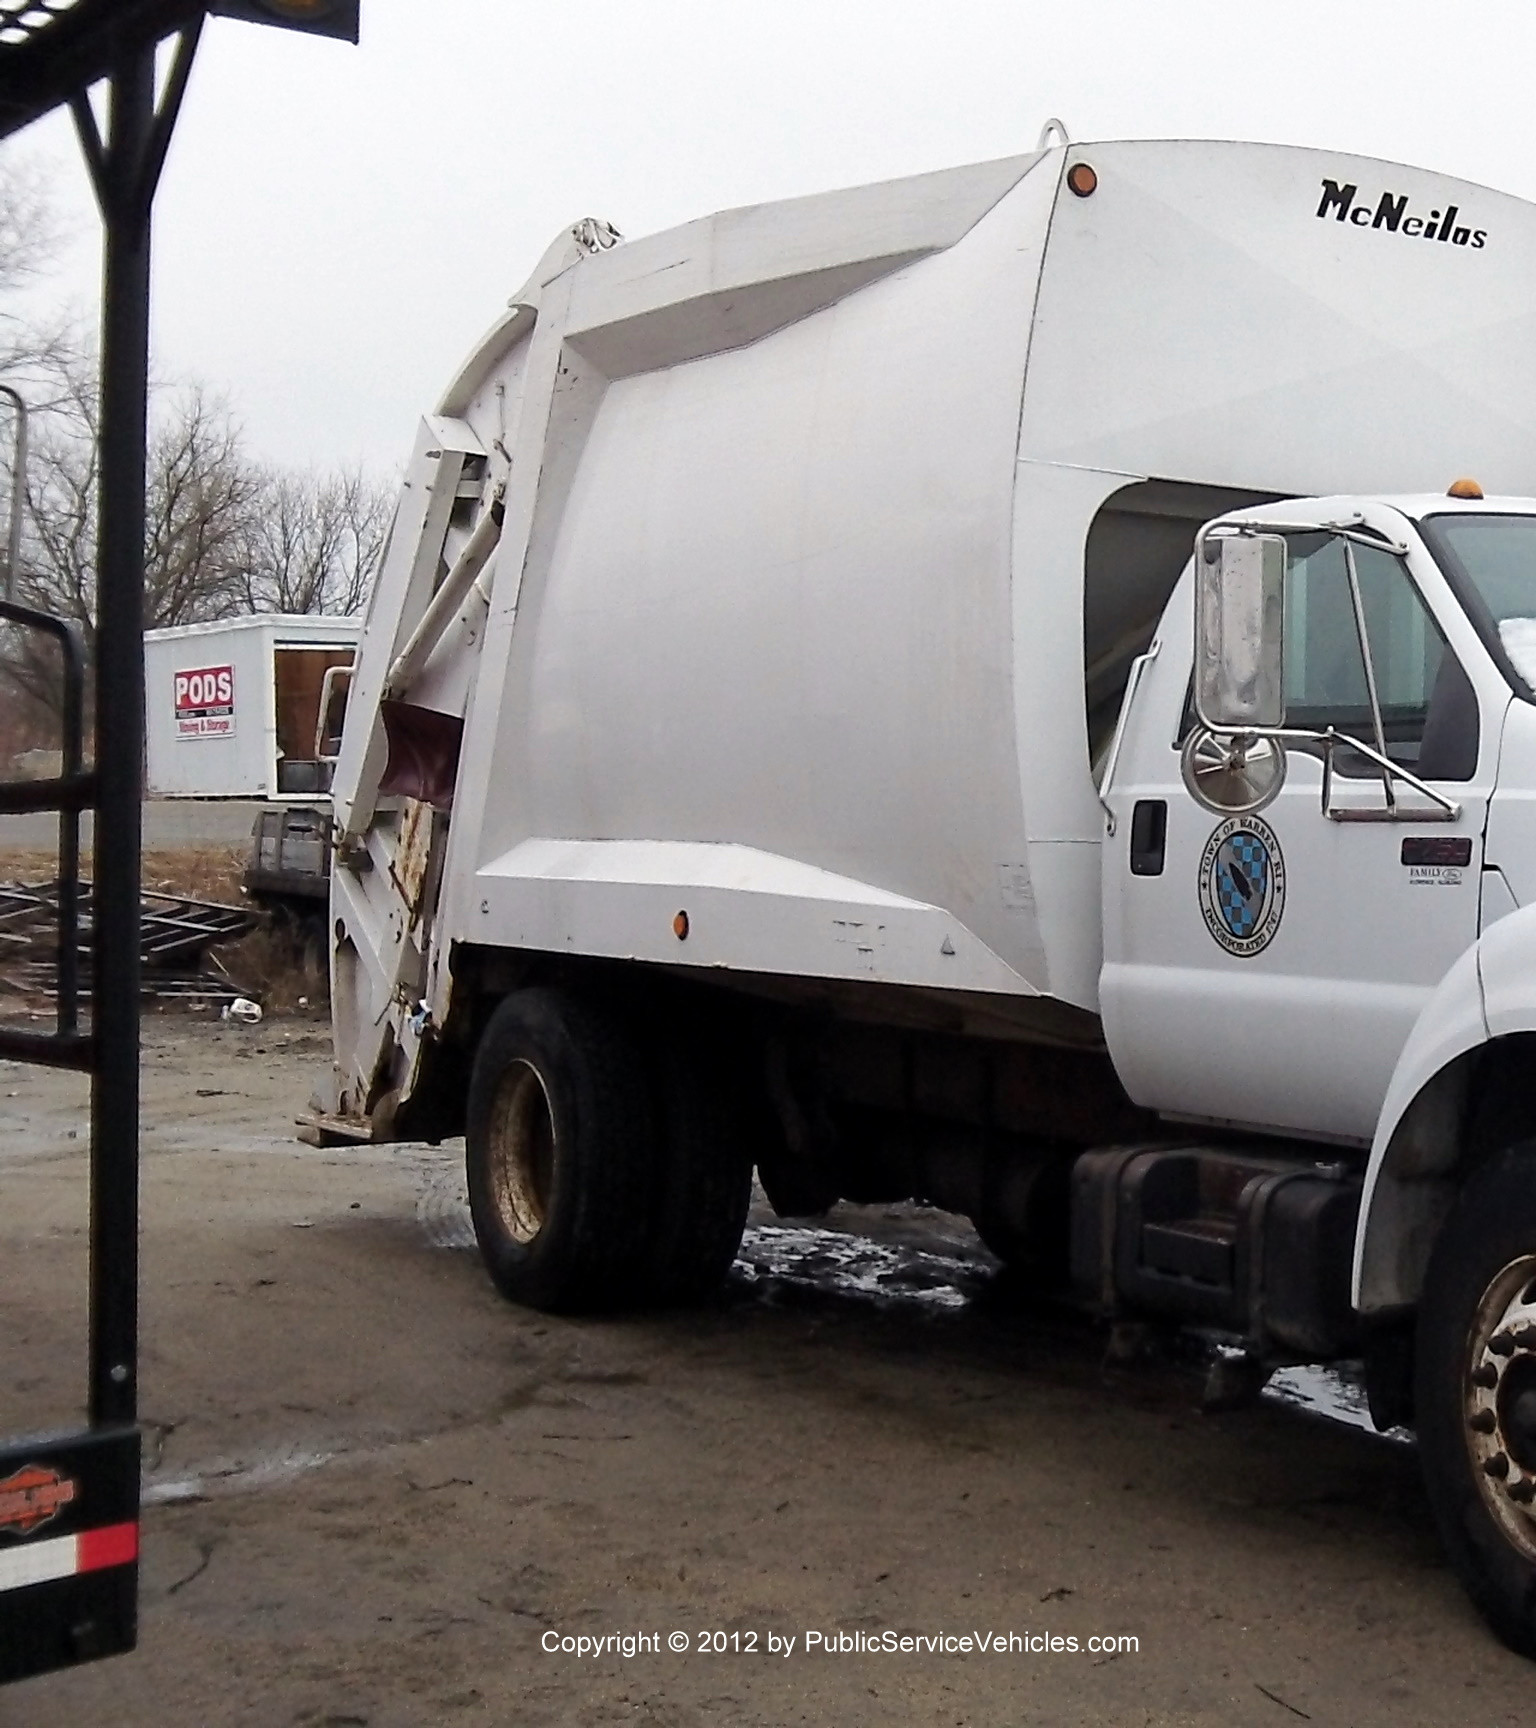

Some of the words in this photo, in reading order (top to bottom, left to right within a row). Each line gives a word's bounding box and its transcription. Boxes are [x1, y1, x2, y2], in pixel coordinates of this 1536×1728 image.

[176, 672, 231, 705] PODS
[1203, 833, 1221, 876] TOWN
[1222, 820, 1236, 835] OF
[1410, 868, 1440, 876] FAMILY
